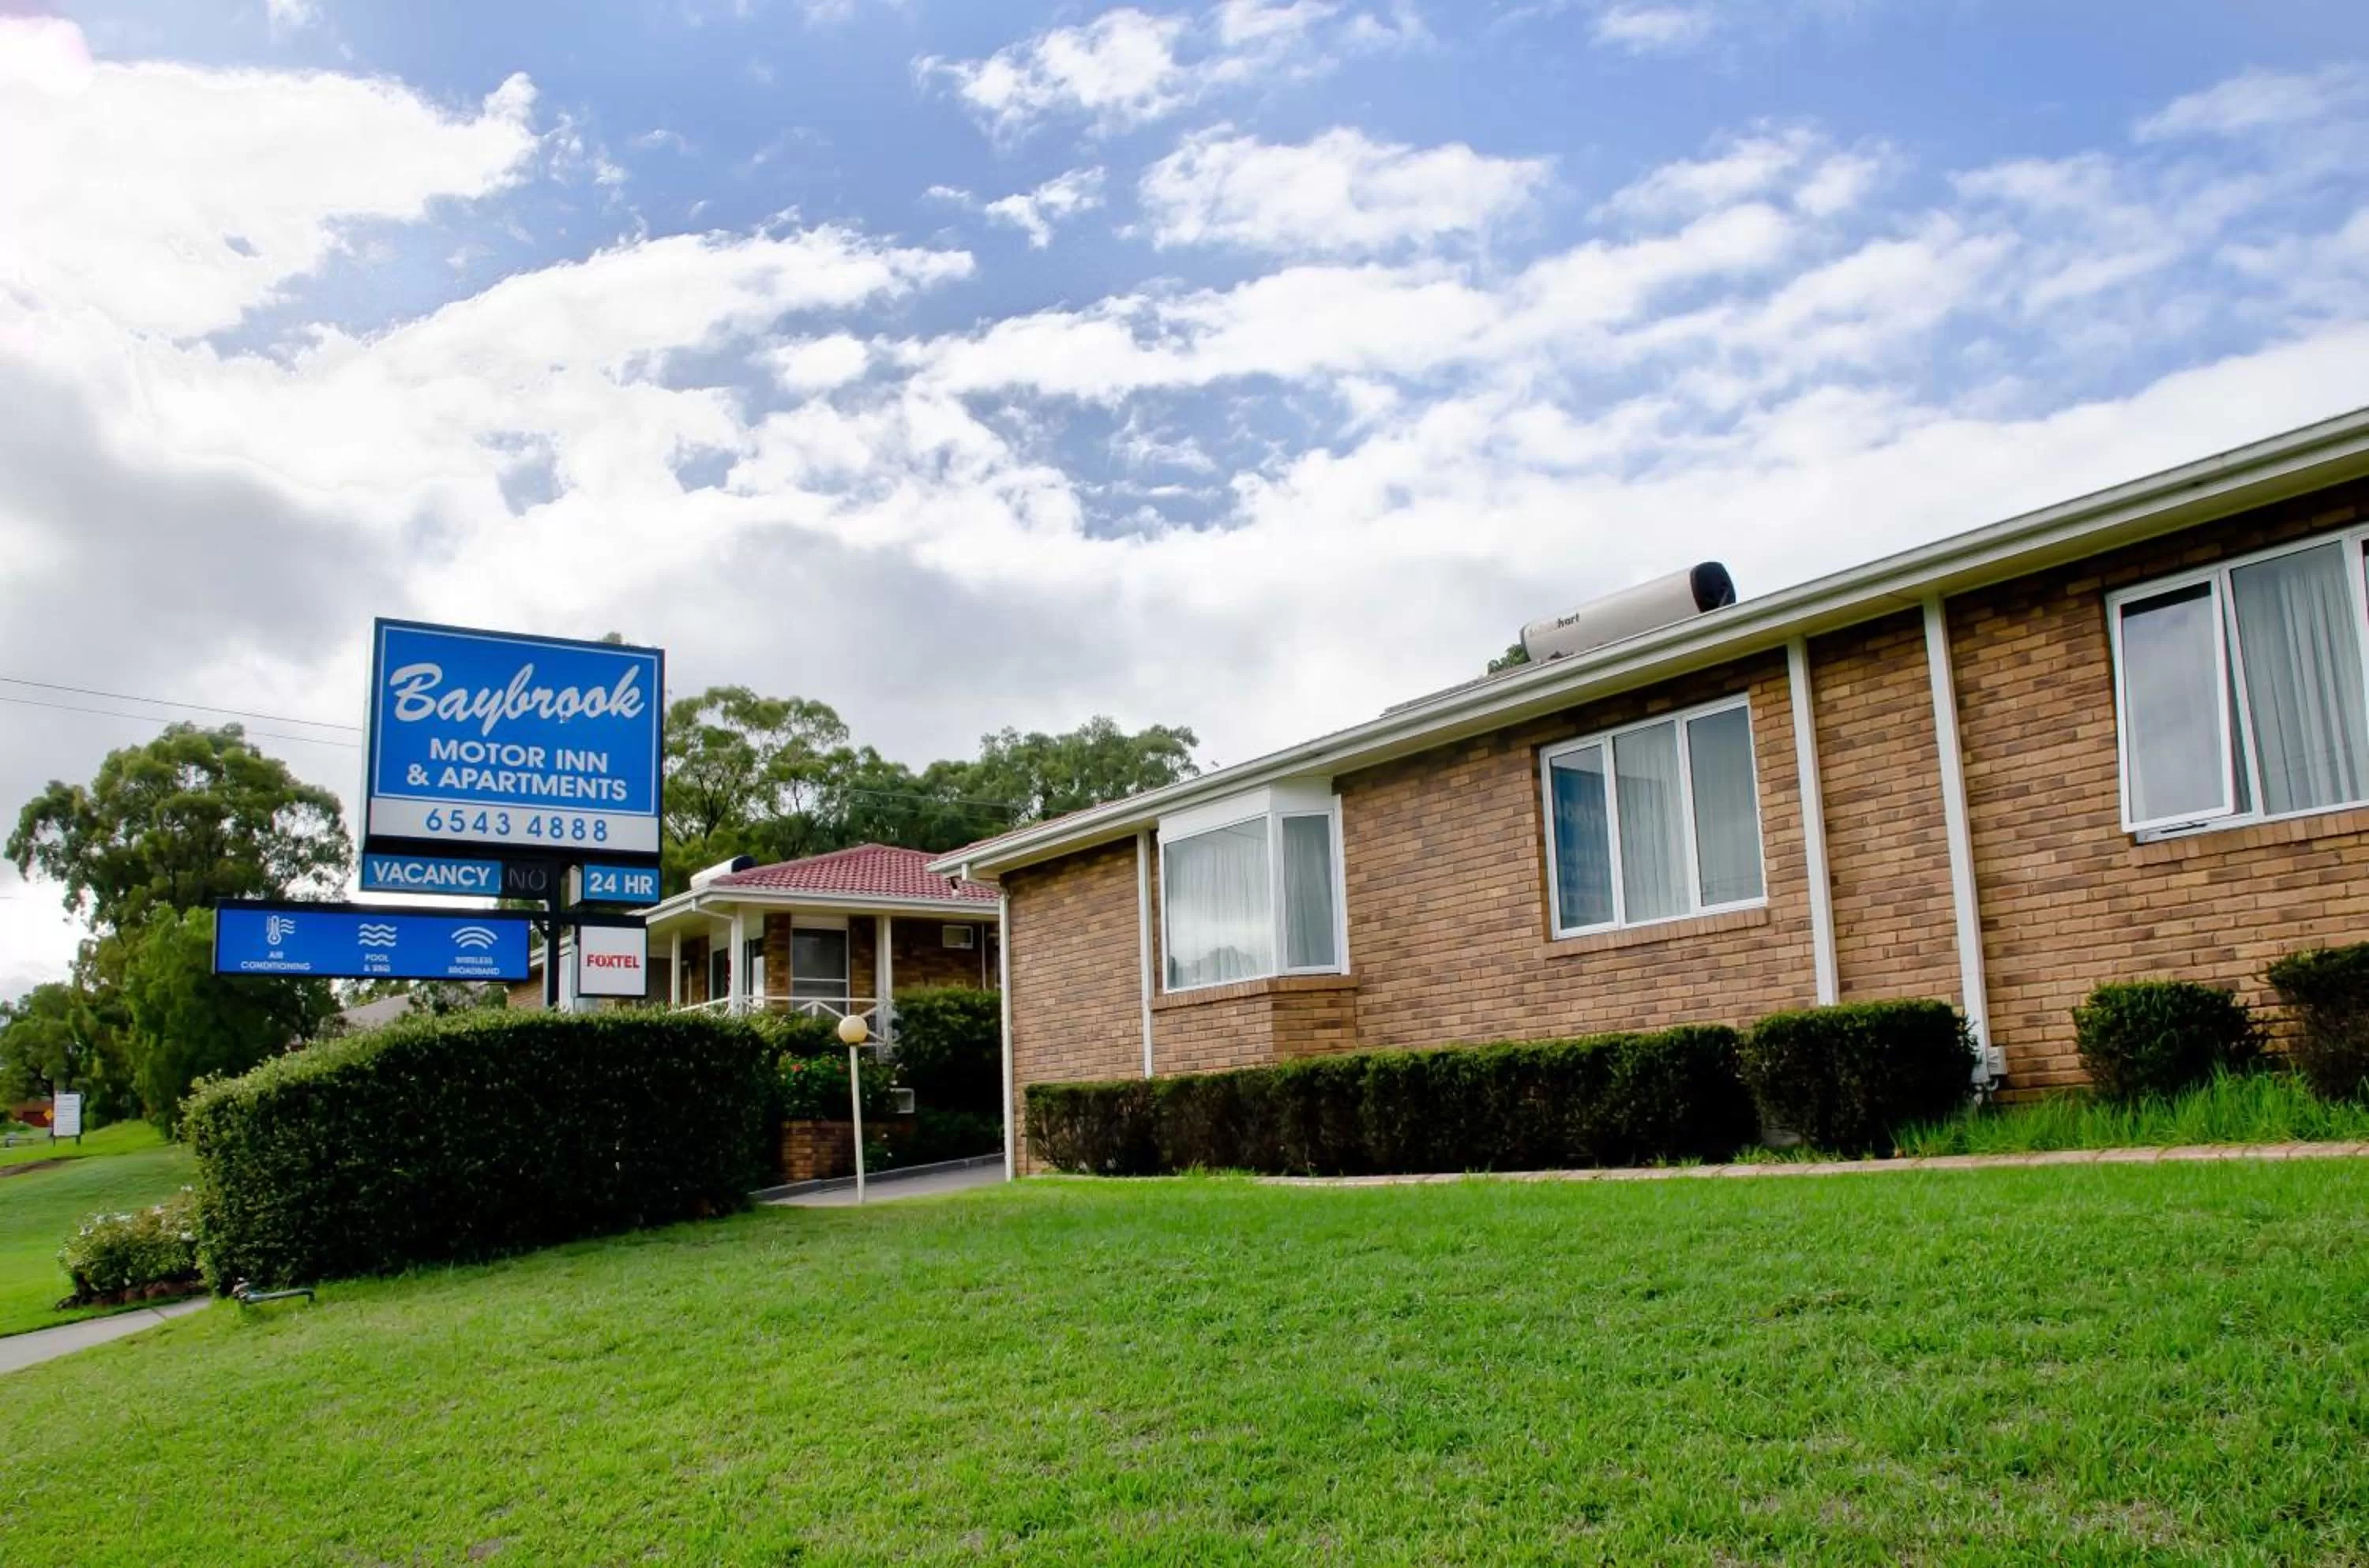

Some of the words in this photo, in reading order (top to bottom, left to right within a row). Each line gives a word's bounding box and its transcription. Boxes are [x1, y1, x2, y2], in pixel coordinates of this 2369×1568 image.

[389, 662, 645, 737] Baybrook
[430, 737, 546, 769] MOTOR
[555, 748, 607, 774] INN
[407, 763, 430, 786] &
[438, 767, 628, 802] APARTMENTS
[426, 807, 512, 836] 6543
[527, 815, 608, 842] 4888
[372, 860, 490, 886] VACANCY
[508, 867, 548, 892] NO
[588, 872, 617, 893] 24
[625, 875, 653, 895] HR
[240, 961, 310, 970] CONDITIONING
[365, 953, 389, 962] POOL
[587, 954, 640, 969] FOXTEL
